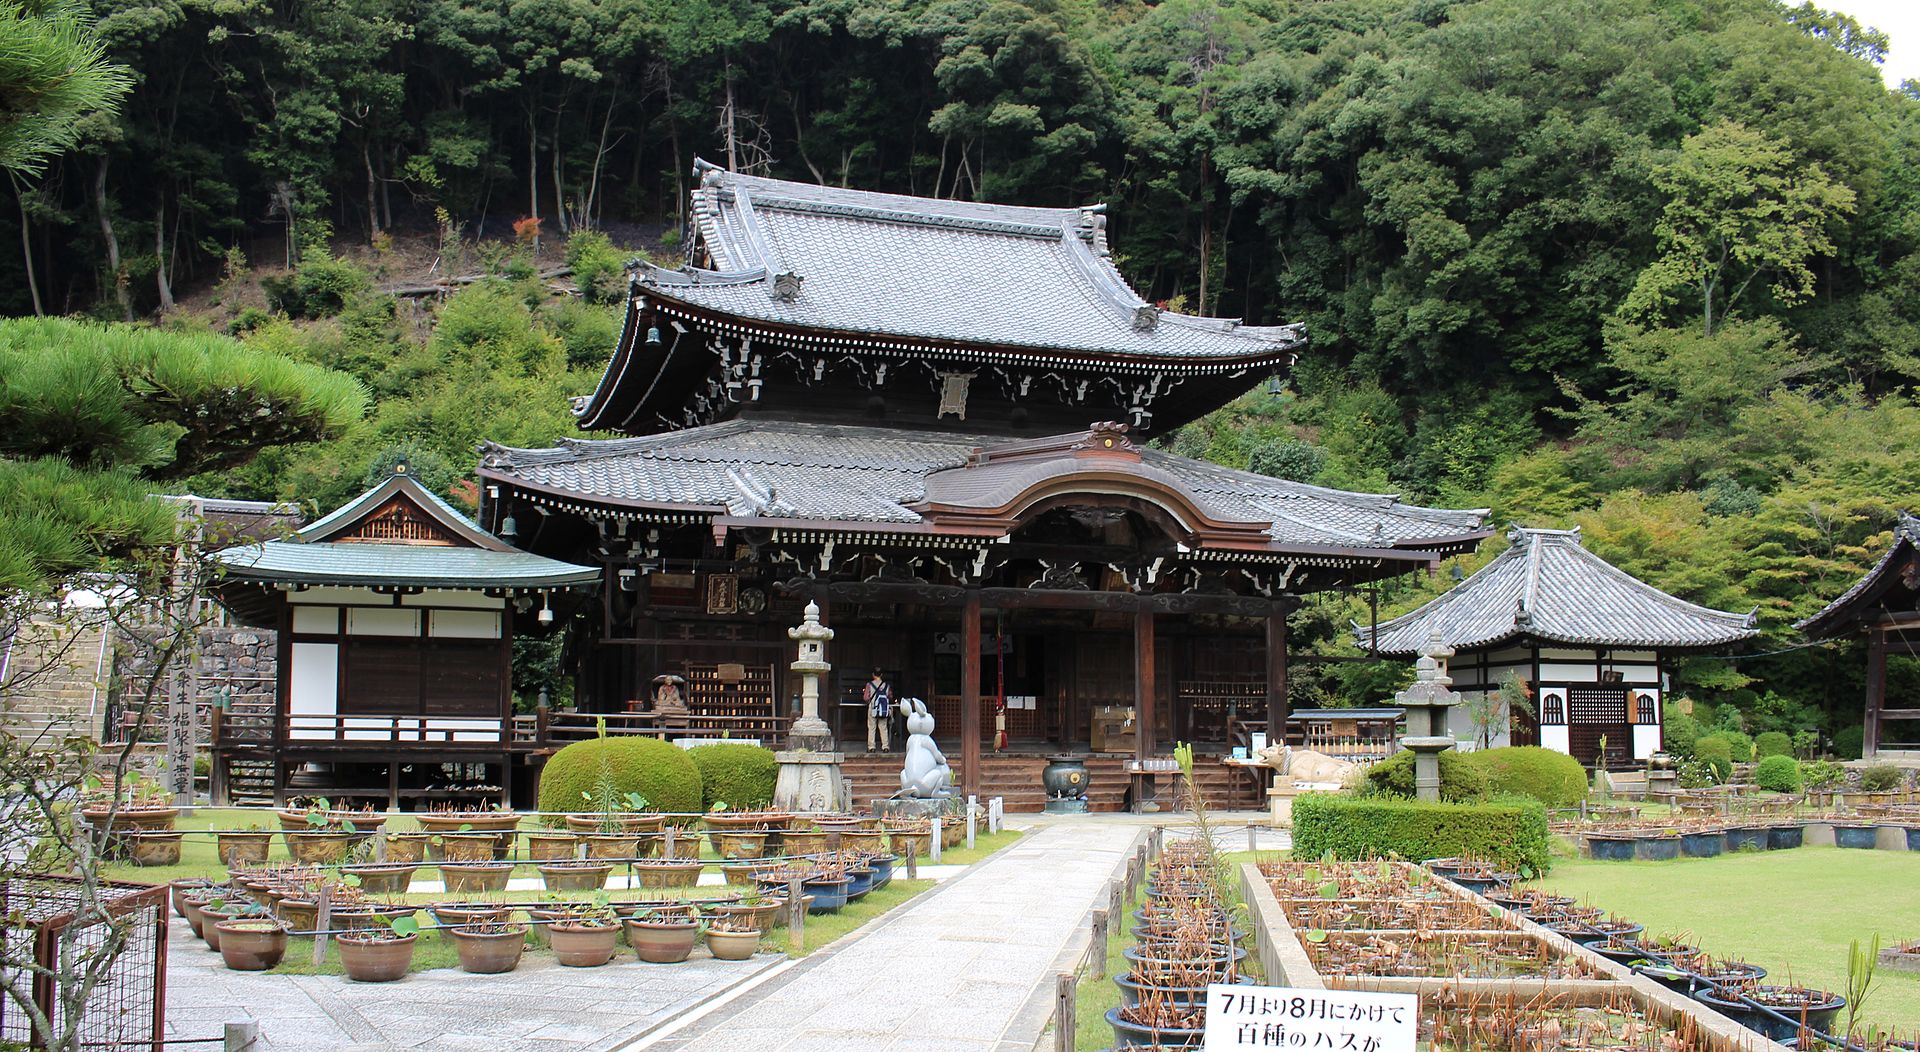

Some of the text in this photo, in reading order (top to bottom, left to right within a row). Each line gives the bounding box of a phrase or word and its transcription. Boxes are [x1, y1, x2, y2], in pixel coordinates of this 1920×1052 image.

[1221, 993, 1405, 1024] 7月より8月にかけて
[1236, 1021, 1382, 1052] 百種のハスが
